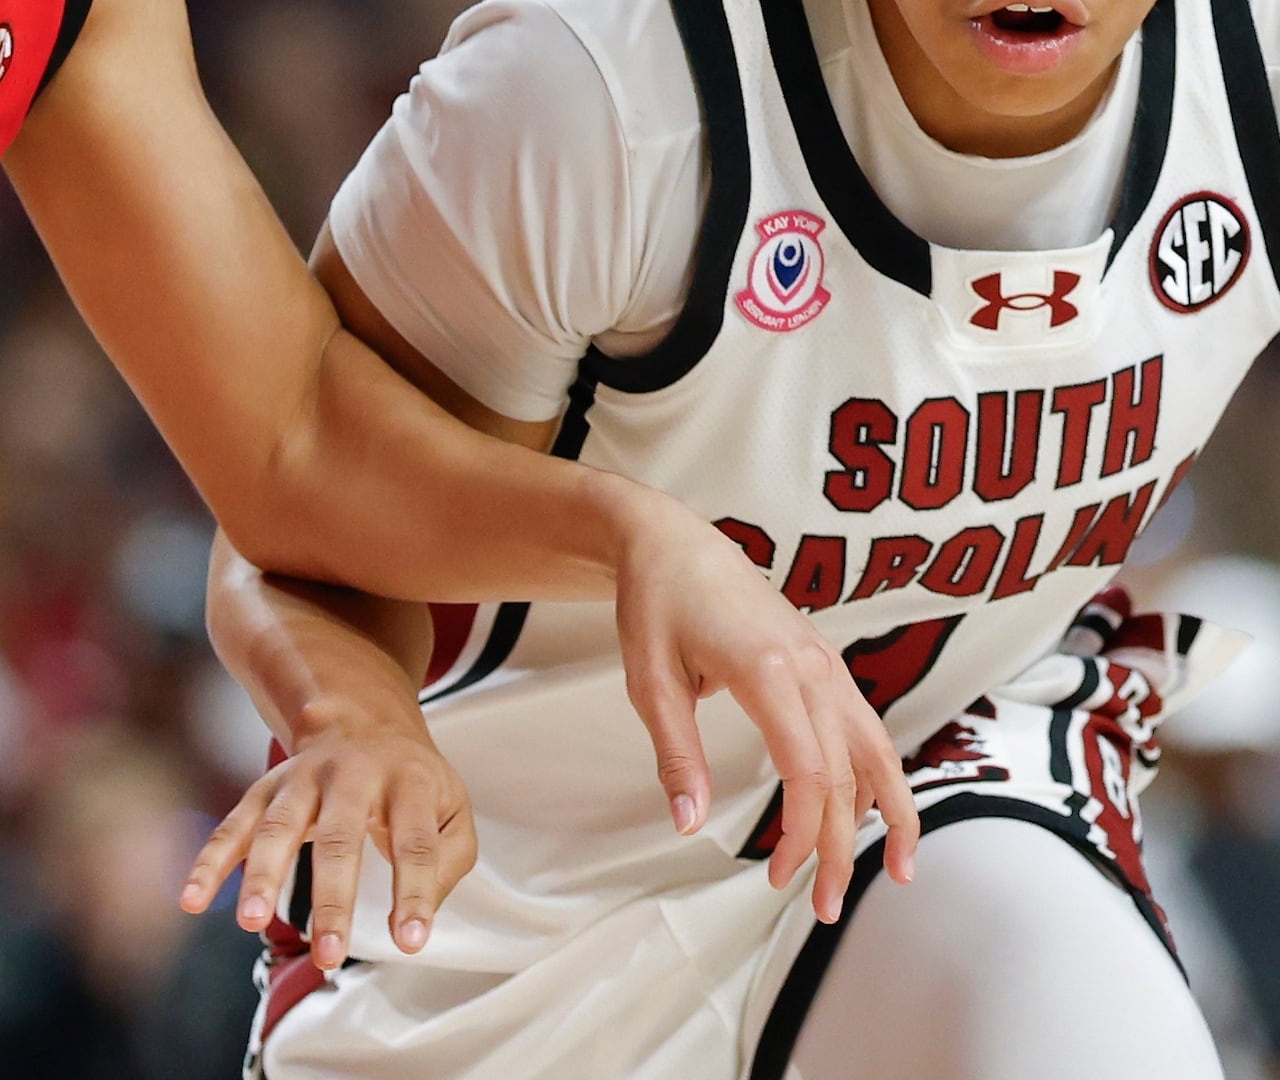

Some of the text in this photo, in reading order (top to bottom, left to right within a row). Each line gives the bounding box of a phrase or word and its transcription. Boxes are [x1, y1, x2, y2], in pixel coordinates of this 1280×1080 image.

[1157, 199, 1243, 306] SEC
[823, 354, 1163, 513] SOUTH
[710, 448, 1198, 616] AROLIN
